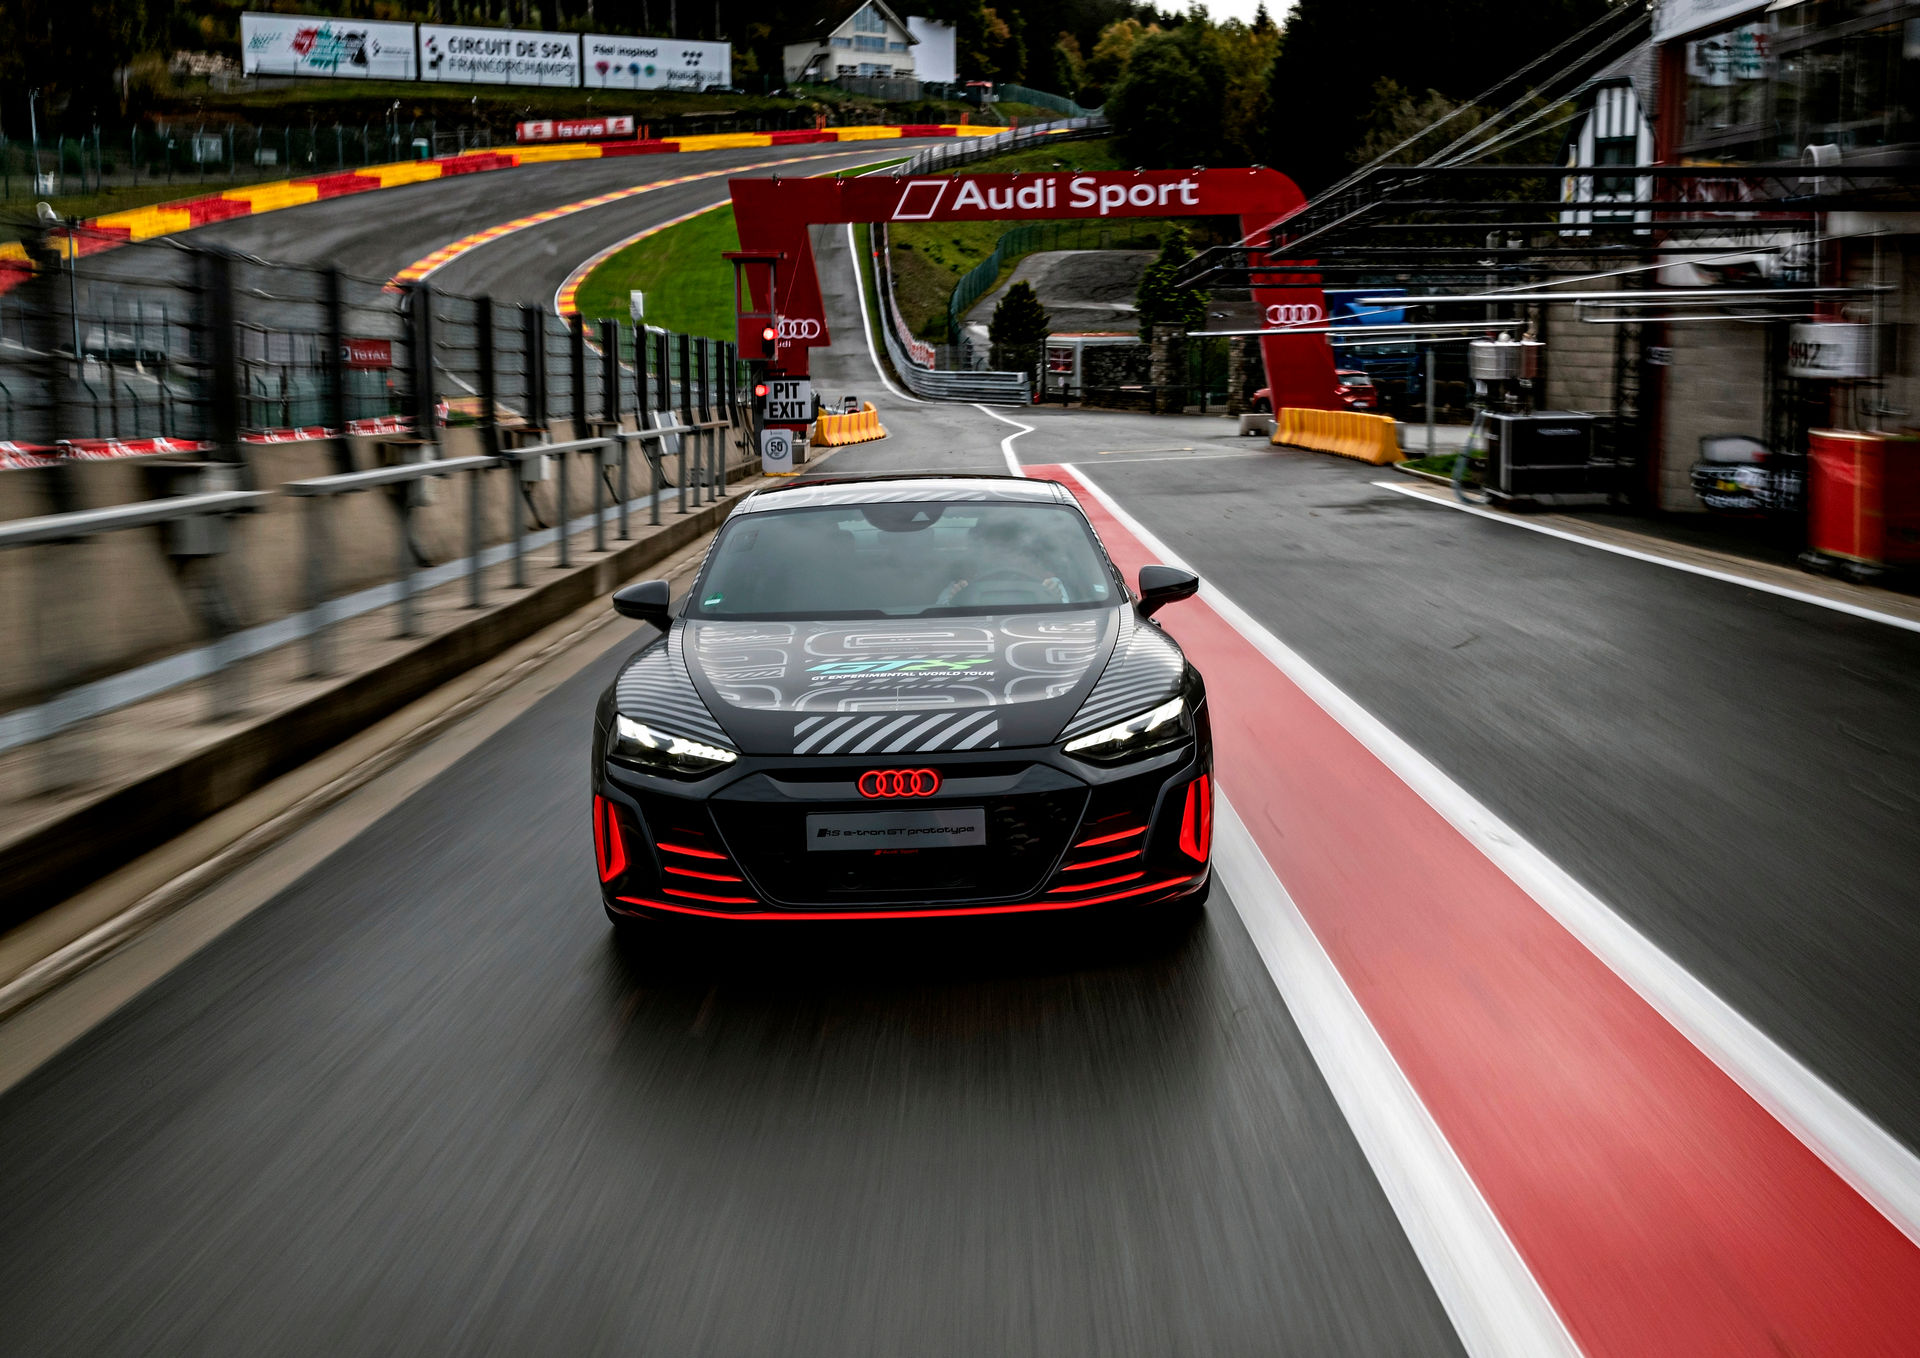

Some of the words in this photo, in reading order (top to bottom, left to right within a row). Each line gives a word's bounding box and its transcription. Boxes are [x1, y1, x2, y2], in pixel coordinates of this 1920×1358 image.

[448, 36, 512, 56] CIRCUIT
[516, 40, 538, 58] DE
[541, 41, 574, 60] SPA
[448, 56, 576, 77] FRANCORCHAMPS
[952, 177, 1057, 211] Audi
[1069, 177, 1200, 215] Sport
[353, 350, 388, 361] TOTAL
[773, 382, 800, 399] PIT
[769, 401, 806, 419] EXIT
[770, 441, 783, 453] 50
[828, 671, 916, 680] EXPERIMENTAL
[843, 828, 886, 837] e-tron
[887, 828, 908, 836] GT
[908, 826, 975, 837] prototype
